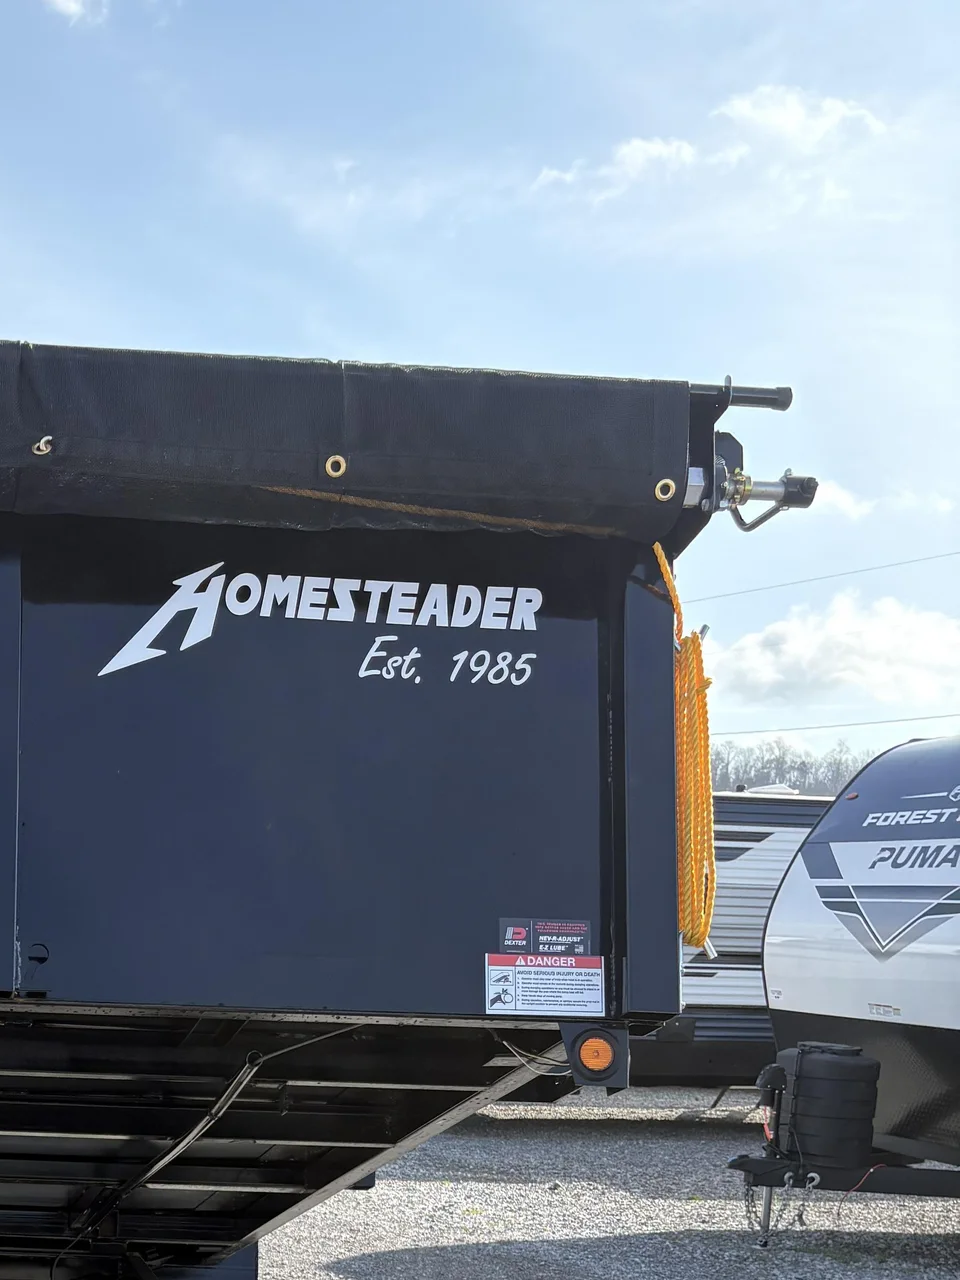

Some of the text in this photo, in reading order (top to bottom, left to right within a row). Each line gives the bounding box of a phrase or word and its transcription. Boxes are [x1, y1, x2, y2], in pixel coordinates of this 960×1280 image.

[97, 561, 543, 676] HOMESTEADER
[358, 635, 537, 686] Est. 1985
[862, 808, 958, 827] FOREST
[868, 845, 960, 869] PUMA
[527, 956, 576, 967] DANGER
